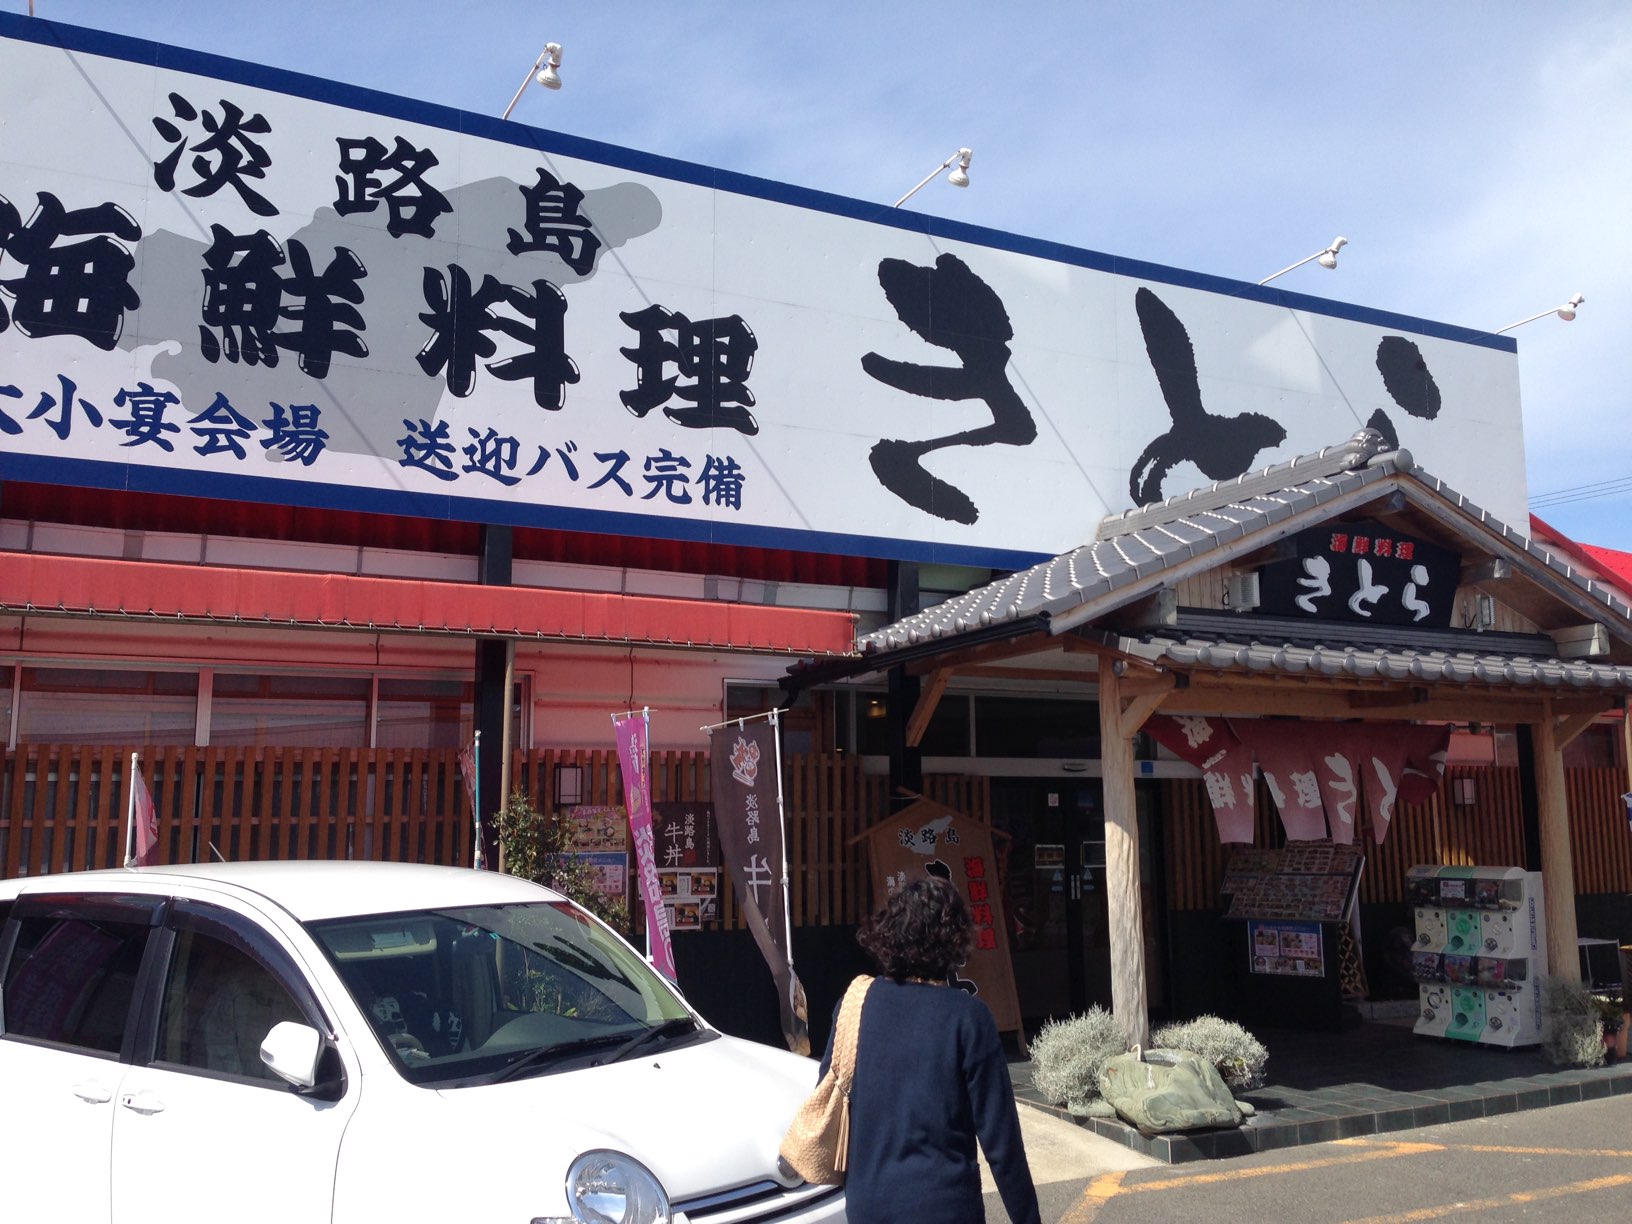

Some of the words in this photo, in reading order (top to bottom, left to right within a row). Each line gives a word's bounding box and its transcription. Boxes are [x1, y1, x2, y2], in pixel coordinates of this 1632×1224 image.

[153, 92, 601, 276] 淡路島
[0, 191, 758, 436] 海鮮料理
[398, 417, 746, 511] 送迎バス完備
[1295, 555, 1430, 622] さとら
[664, 822, 684, 866] 牛丼
[684, 813, 695, 850] 淡路島
[899, 828, 960, 846] 淡路島
